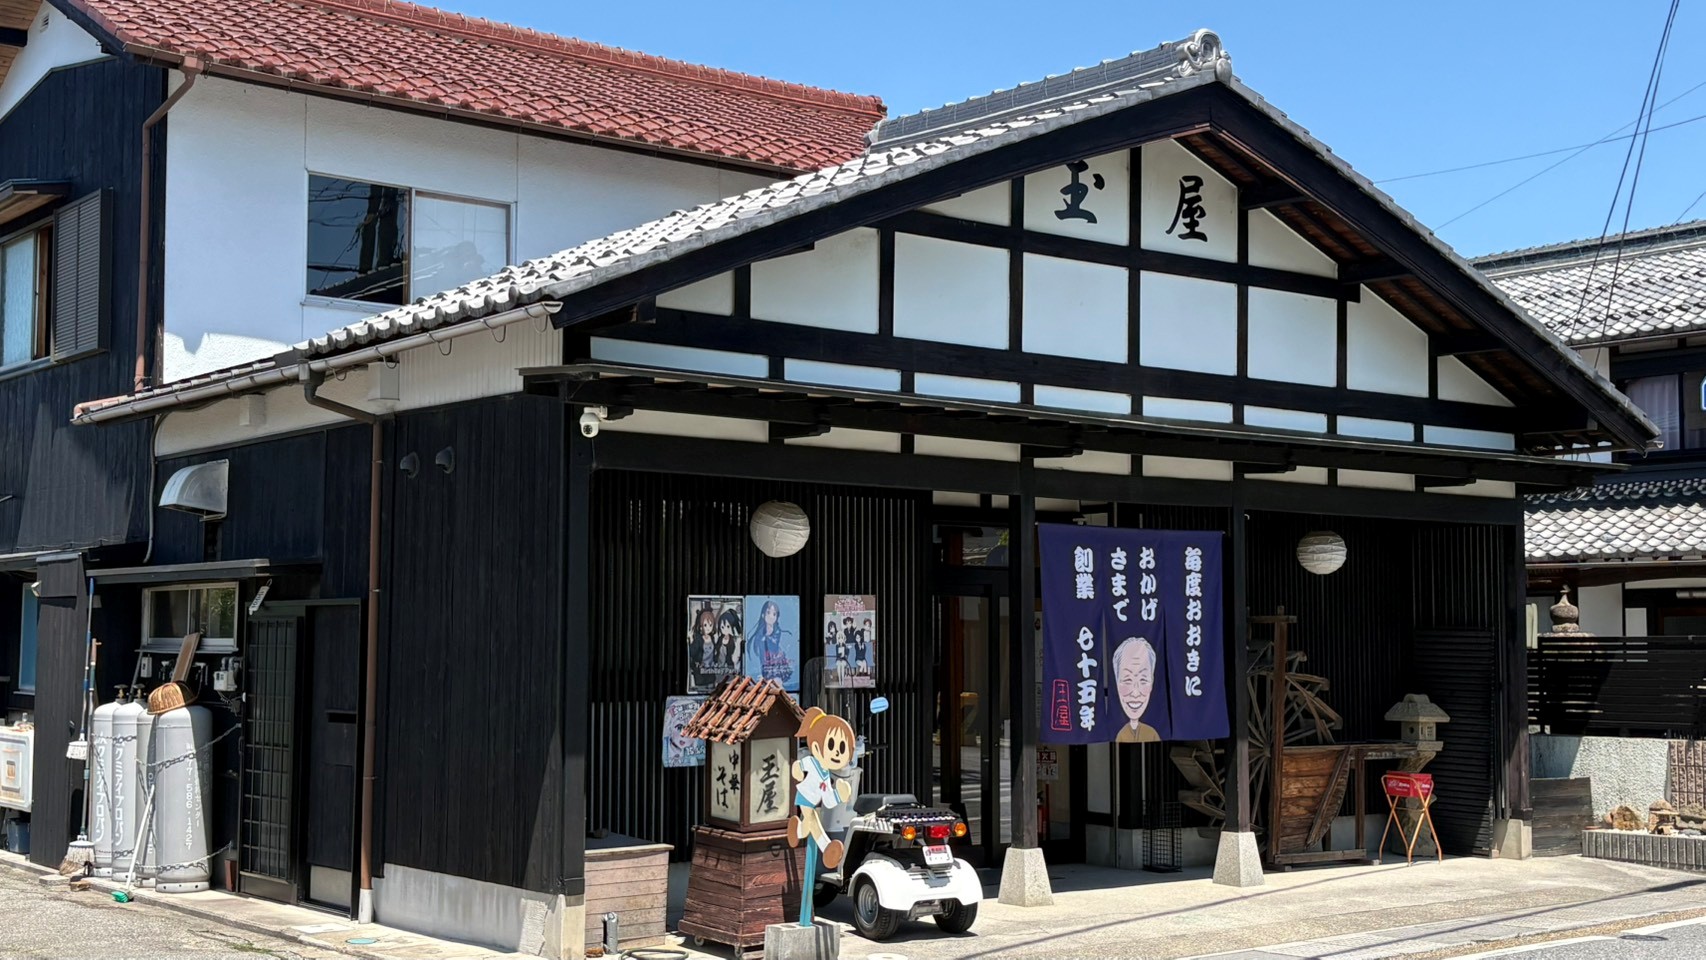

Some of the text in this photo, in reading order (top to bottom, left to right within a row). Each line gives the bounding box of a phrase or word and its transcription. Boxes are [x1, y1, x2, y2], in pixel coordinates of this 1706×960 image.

[1054, 159, 1208, 242] 玉屋
[1073, 545, 1095, 599] 創業
[1110, 547, 1130, 622] さまで
[1138, 546, 1158, 621] おかげ
[1184, 546, 1203, 697] 毎度おおきに
[728, 749, 740, 795] 中華
[756, 753, 780, 815] 玉屋
